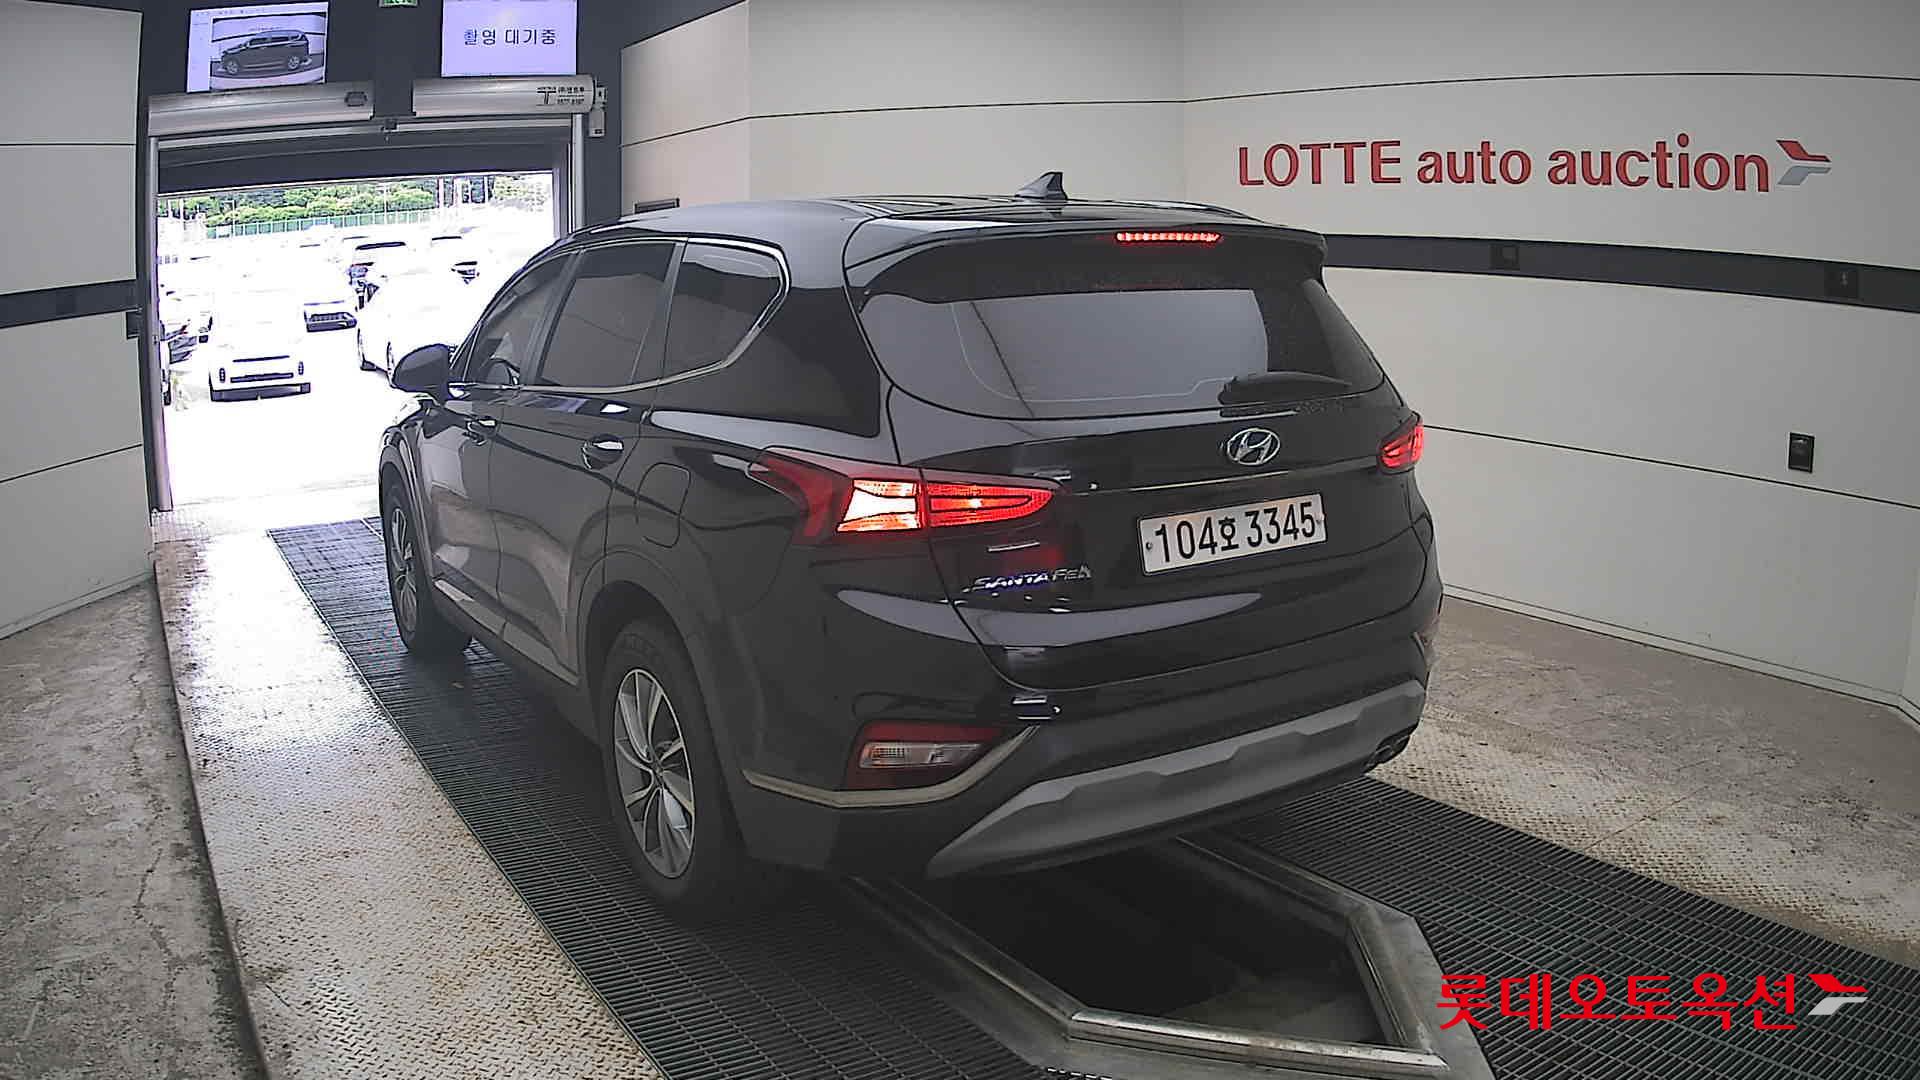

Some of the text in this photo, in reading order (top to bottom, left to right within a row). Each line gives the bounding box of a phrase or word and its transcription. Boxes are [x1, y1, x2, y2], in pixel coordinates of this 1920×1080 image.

[505, 29, 556, 45] 대기중
[1239, 134, 1770, 193] LOTTE auto auction
